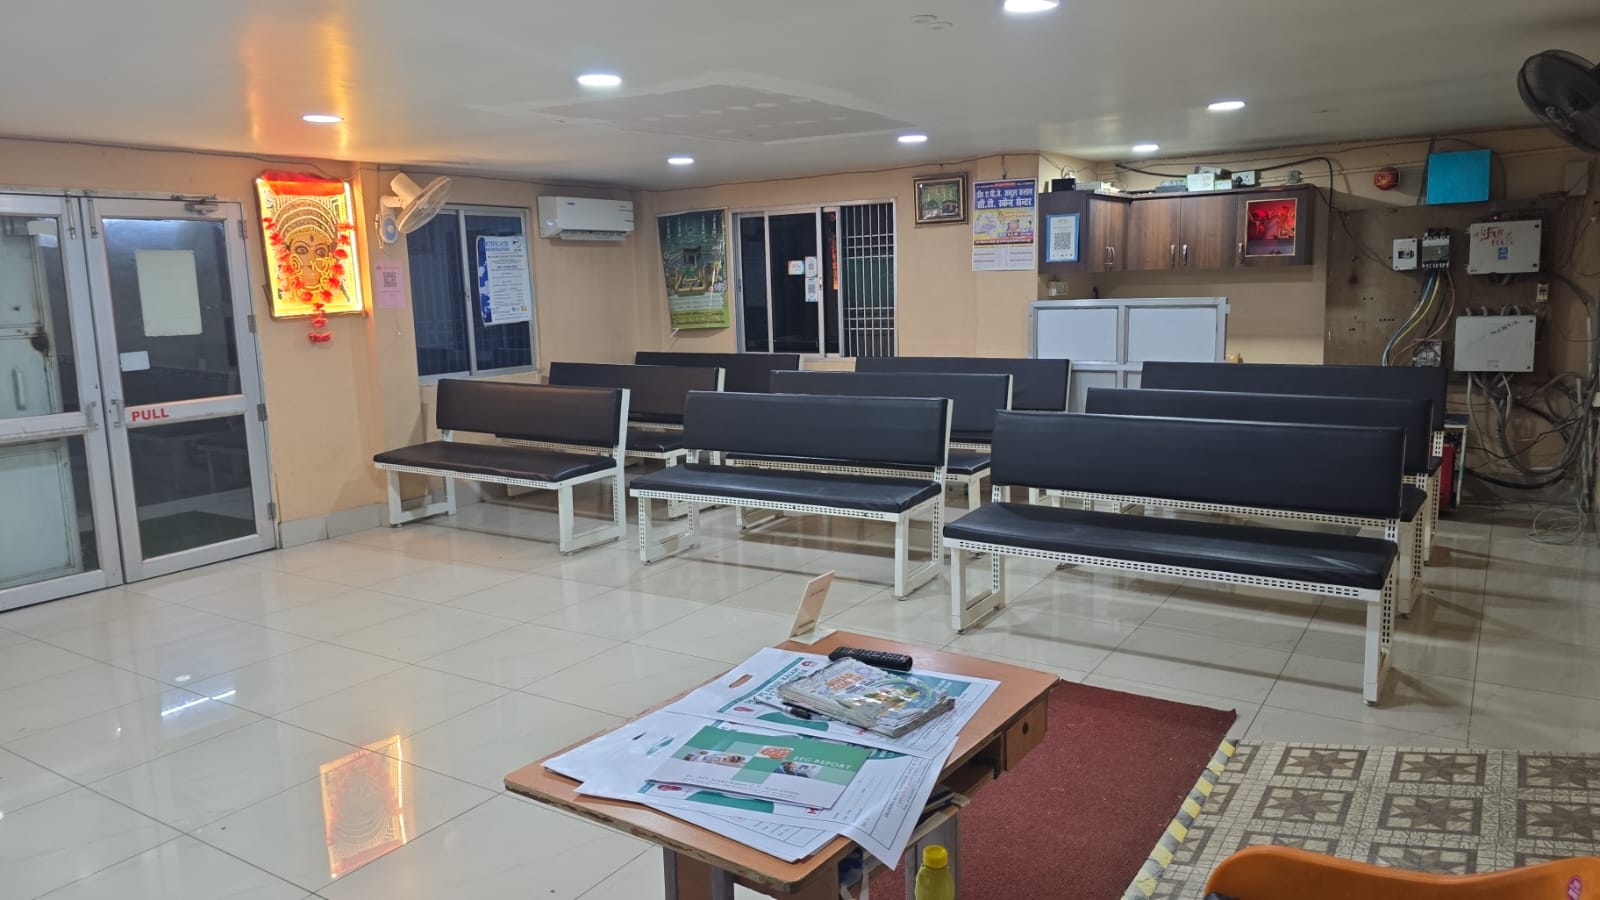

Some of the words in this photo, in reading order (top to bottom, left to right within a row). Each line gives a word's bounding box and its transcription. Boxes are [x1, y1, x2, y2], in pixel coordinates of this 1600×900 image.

[131, 407, 169, 422] PULL
[793, 755, 813, 763] EEG
[814, 759, 852, 770] REPORT
